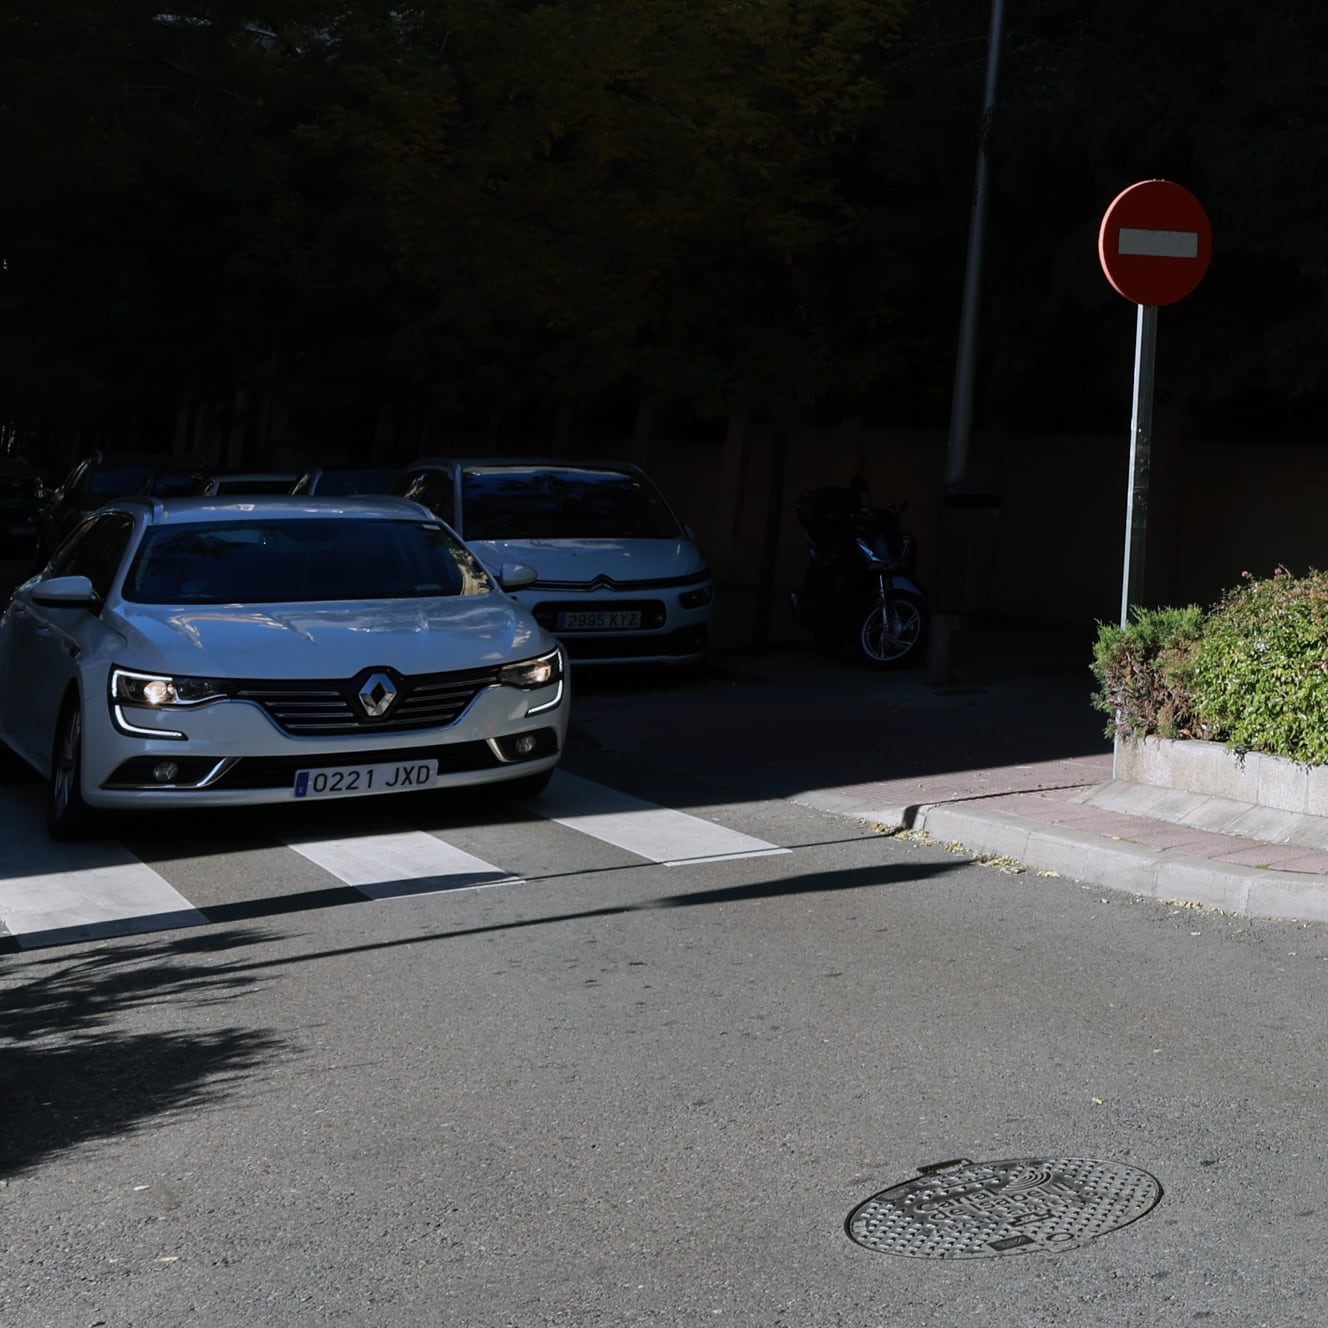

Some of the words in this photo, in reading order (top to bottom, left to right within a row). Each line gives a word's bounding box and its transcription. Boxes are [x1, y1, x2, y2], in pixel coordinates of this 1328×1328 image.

[568, 614, 605, 627] 2995
[609, 613, 637, 626] KYZ
[313, 769, 374, 793] 0221
[385, 764, 431, 787] JXD
[915, 1188, 998, 1211] Canal
[929, 1208, 967, 1220] de
[969, 1187, 1051, 1211] Isabel
